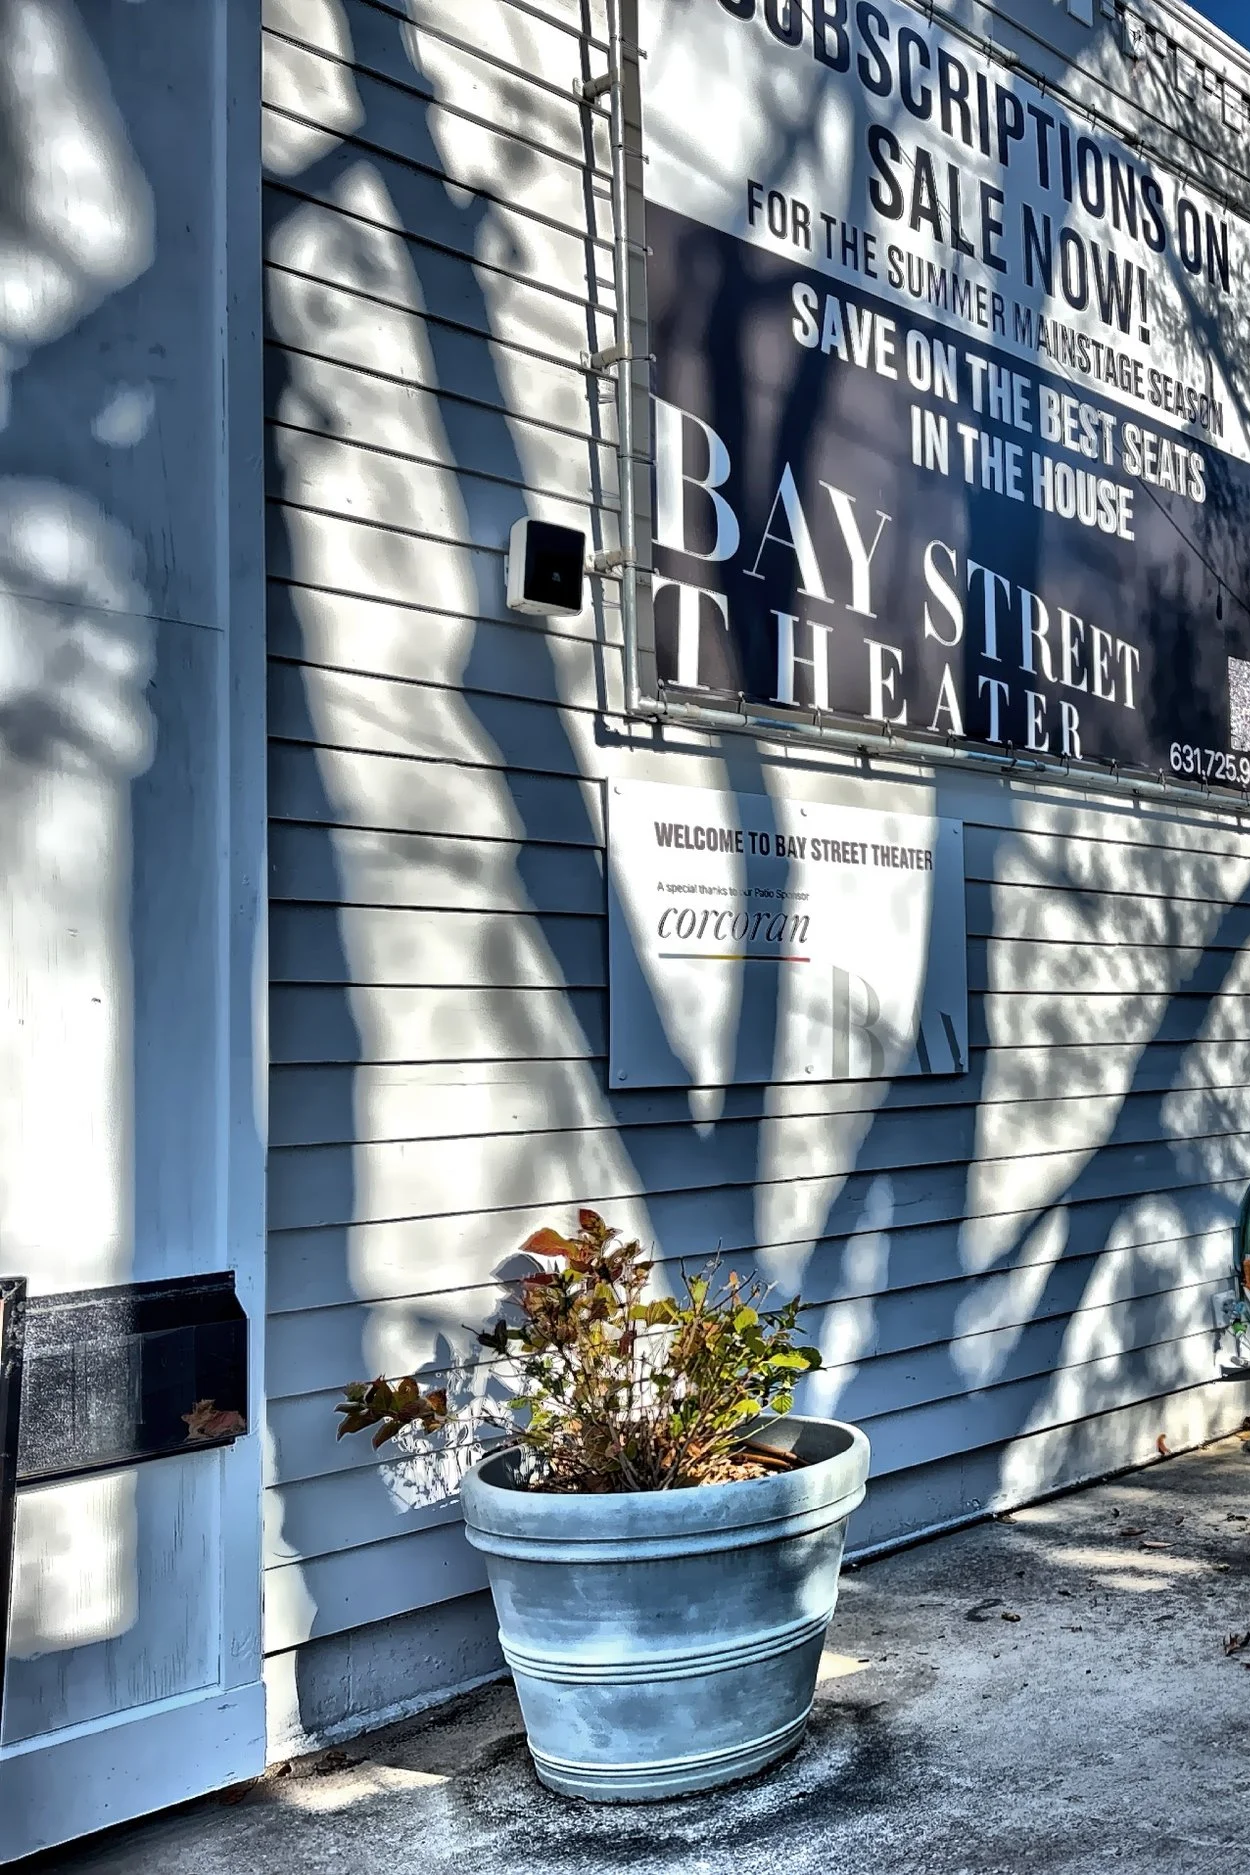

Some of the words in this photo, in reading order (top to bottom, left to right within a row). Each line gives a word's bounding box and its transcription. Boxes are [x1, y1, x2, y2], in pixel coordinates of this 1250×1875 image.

[716, 0, 1167, 253] BSCRIPTIONS
[1178, 198, 1231, 294] ON
[867, 124, 1007, 274] SALE
[1022, 203, 1150, 345] NOW!
[748, 179, 812, 251] FOR
[820, 212, 877, 279] THE
[888, 244, 1006, 337] SUMMER
[1014, 301, 1145, 400] MAINSTAGE
[1148, 367, 1224, 438] SEASON
[791, 281, 898, 381] SAVE
[906, 329, 958, 404] ON
[965, 352, 1032, 434] THE
[1039, 383, 1116, 466] BEST
[1121, 421, 1206, 504] SEATS
[649, 392, 893, 619] BAY
[923, 539, 1140, 710] STREET
[911, 404, 949, 477] IN
[957, 422, 1024, 502] THE
[1031, 451, 1134, 541] HOUSE
[651, 573, 1084, 761] THEATER
[654, 821, 743, 854] WELCOME
[748, 830, 771, 857] TO
[775, 834, 808, 860] BAY
[810, 837, 869, 865] STREET
[871, 843, 934, 871] THEATER
[656, 880, 665, 892] A
[665, 883, 698, 895] special
[728, 886, 739, 897] to
[754, 887, 775, 899] Patio
[656, 906, 811, 944] corcoran
